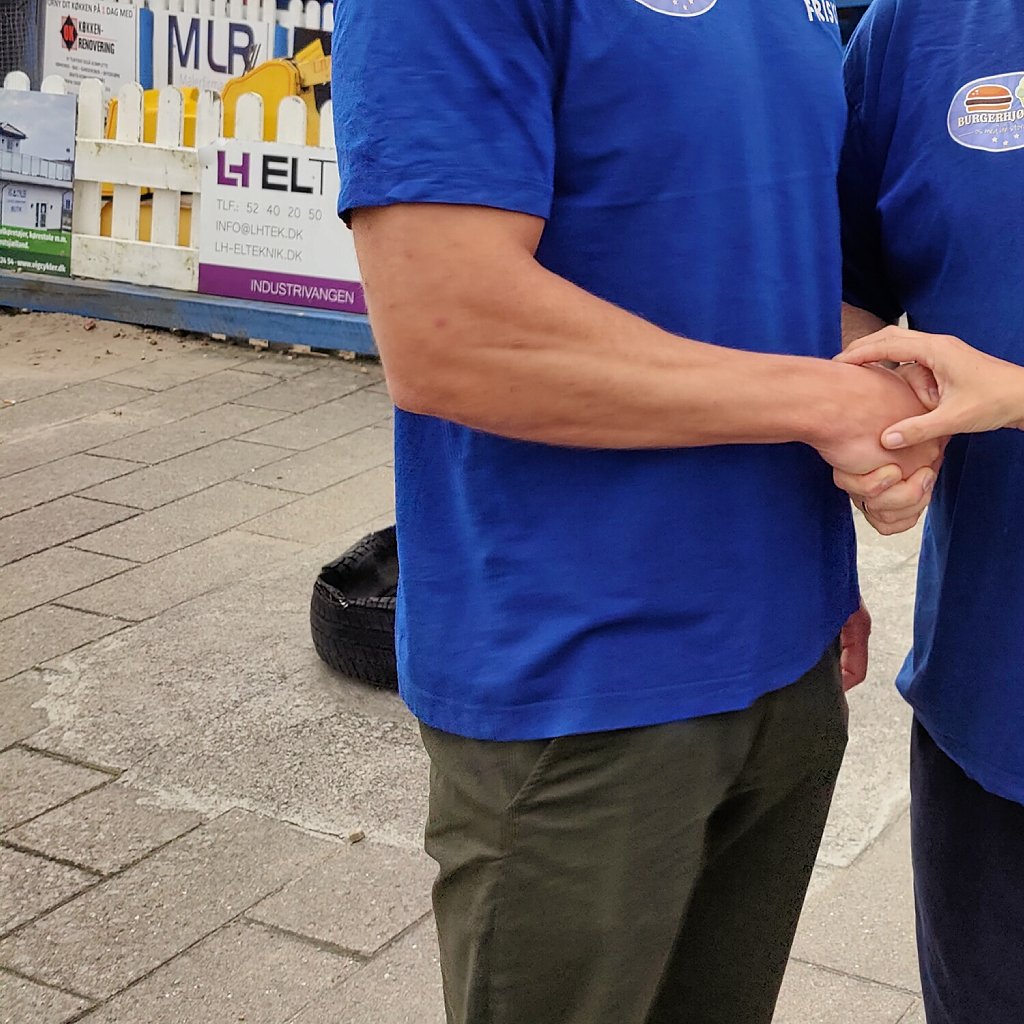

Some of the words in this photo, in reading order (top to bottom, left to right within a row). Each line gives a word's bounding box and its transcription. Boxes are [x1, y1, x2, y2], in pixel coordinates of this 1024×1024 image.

[72, 3, 92, 13] KØKKEN
[94, 3, 101, 15] PÅ
[107, 7, 118, 16] DAG
[120, 9, 133, 18] MED
[78, 38, 115, 55] RENOVERING
[247, 202, 259, 214] 52
[267, 204, 280, 217] 40
[288, 206, 301, 219] 20
[308, 208, 322, 221] 50
[215, 221, 304, 241] INFO@LHTEK.DK
[214, 241, 303, 262] LH-ELTEKNIK.DK
[250, 279, 355, 304] INDUSTRIVANGEN
